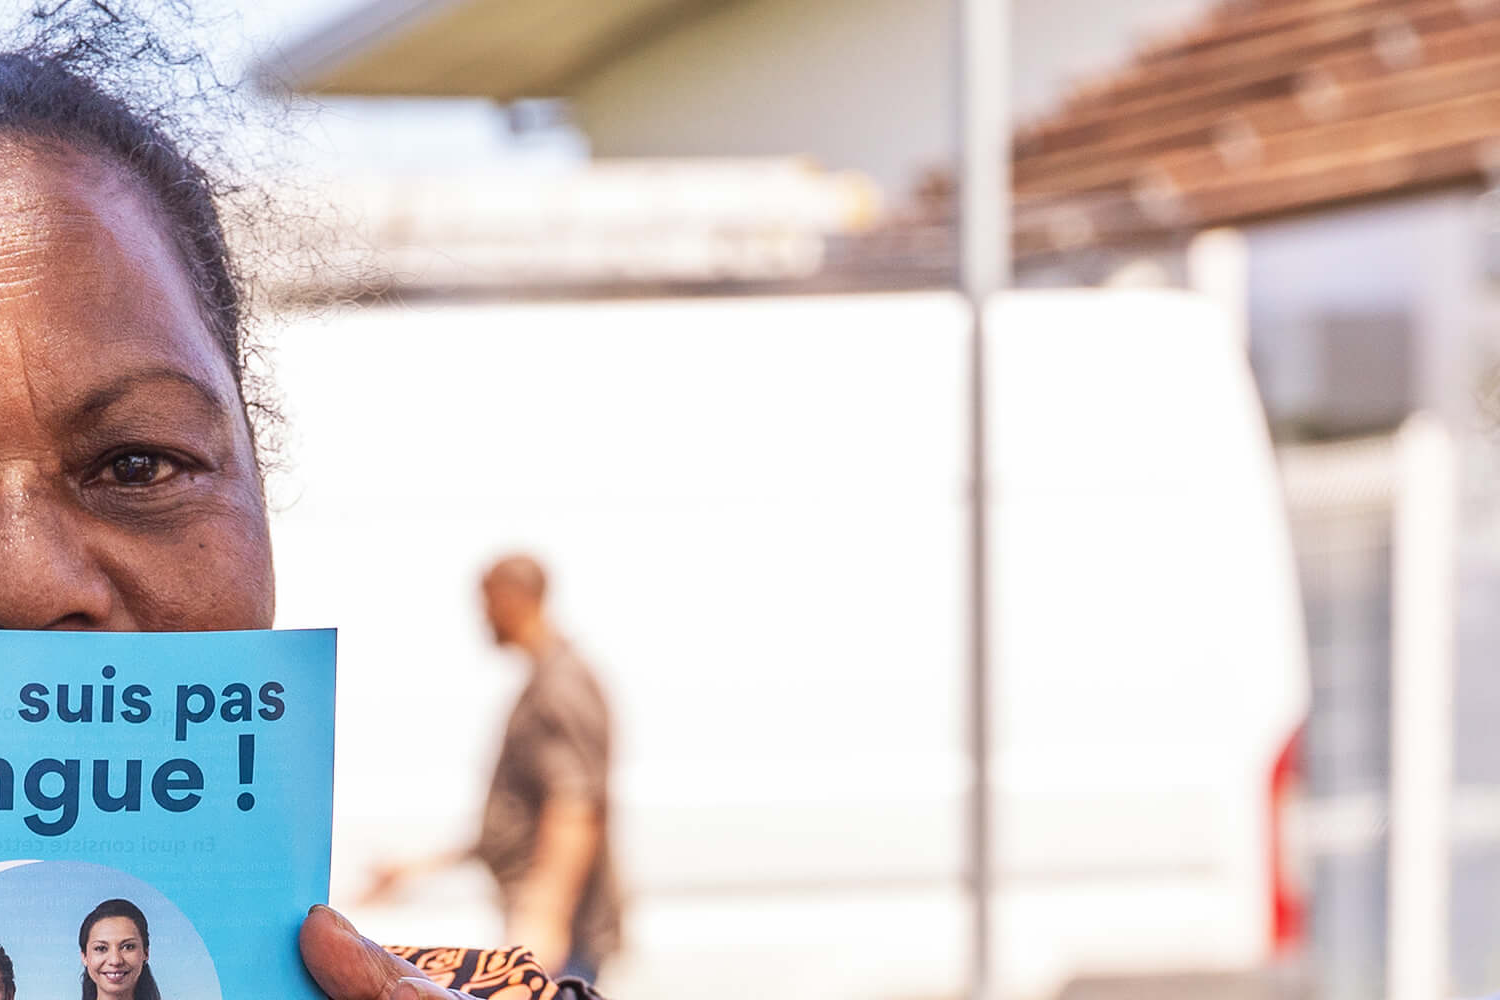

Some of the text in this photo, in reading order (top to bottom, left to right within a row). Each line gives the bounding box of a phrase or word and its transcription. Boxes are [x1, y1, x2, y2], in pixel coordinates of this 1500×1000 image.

[19, 666, 153, 723] suis
[174, 680, 286, 741] pas
[236, 733, 257, 812] !
